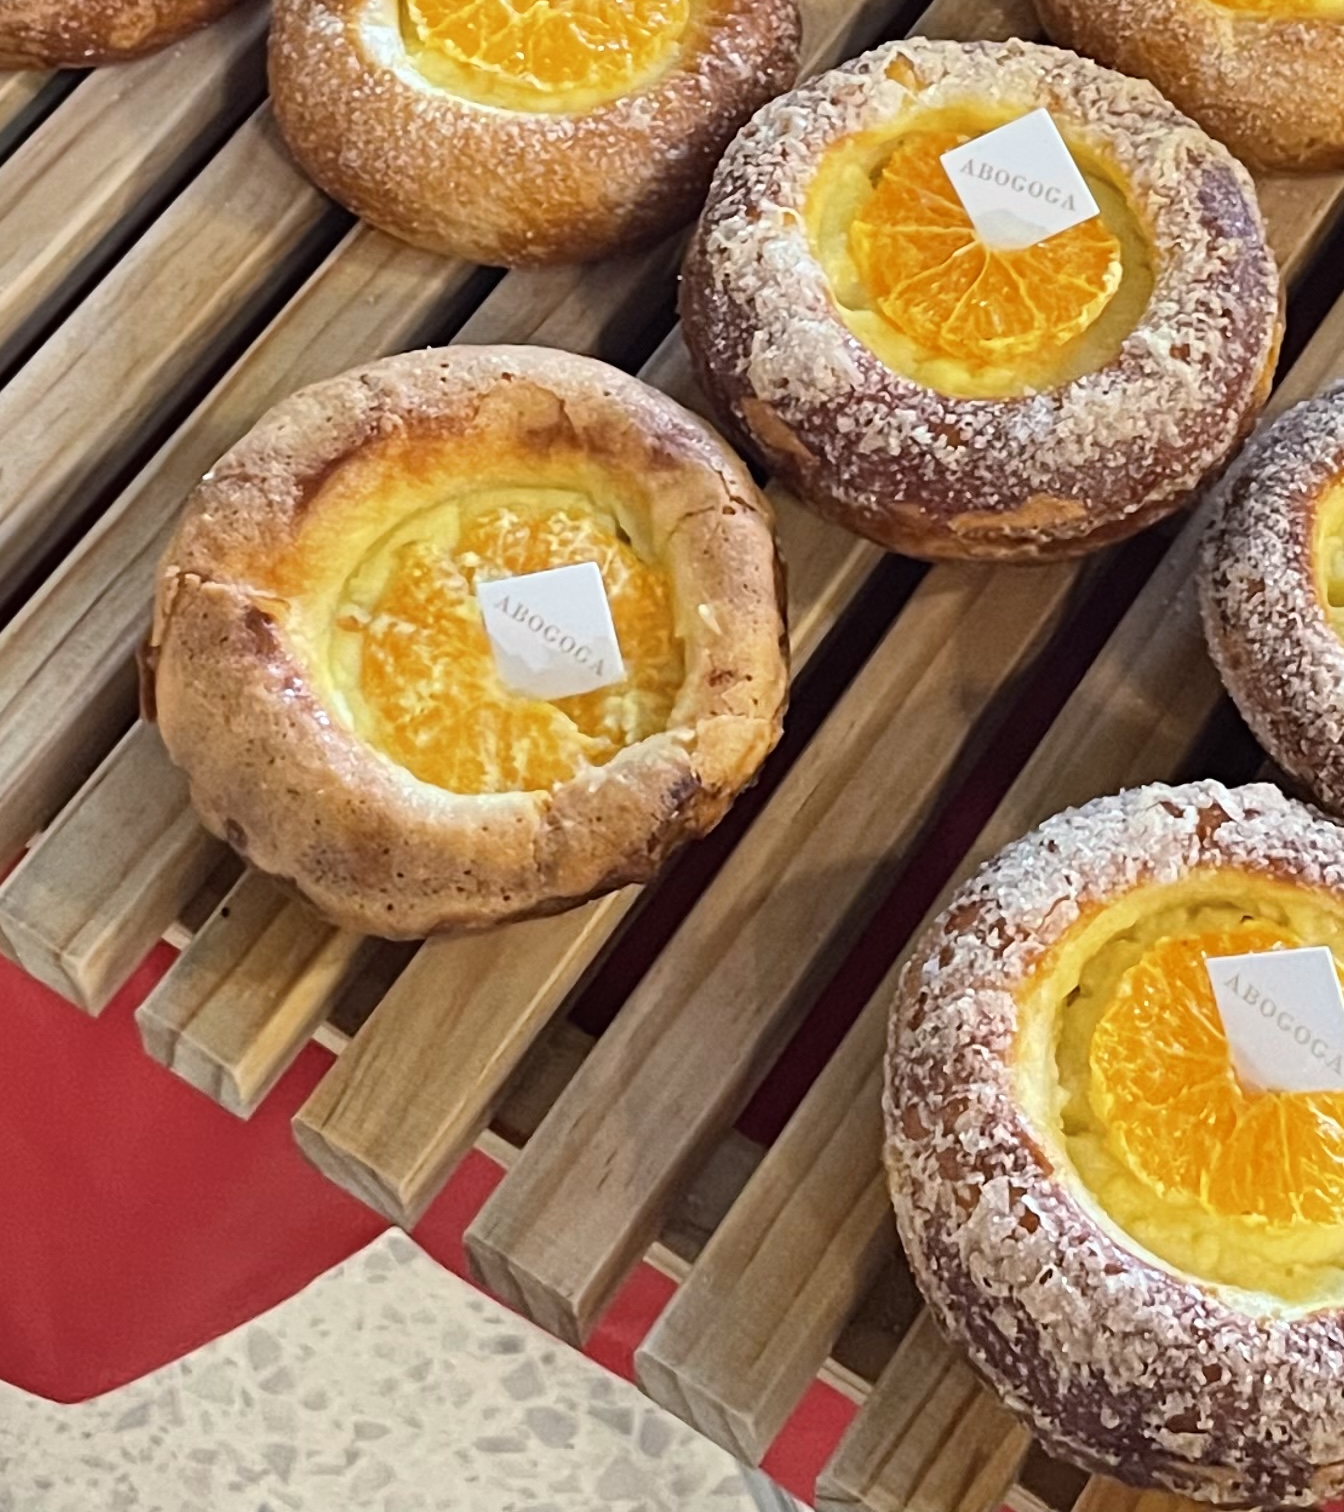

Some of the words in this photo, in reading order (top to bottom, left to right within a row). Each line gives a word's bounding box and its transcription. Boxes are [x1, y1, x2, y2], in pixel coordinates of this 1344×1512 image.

[959, 157, 1078, 213] ABOGOGA
[493, 594, 606, 678] ABOGOGA
[1223, 972, 1344, 1076] ABOGOGA
